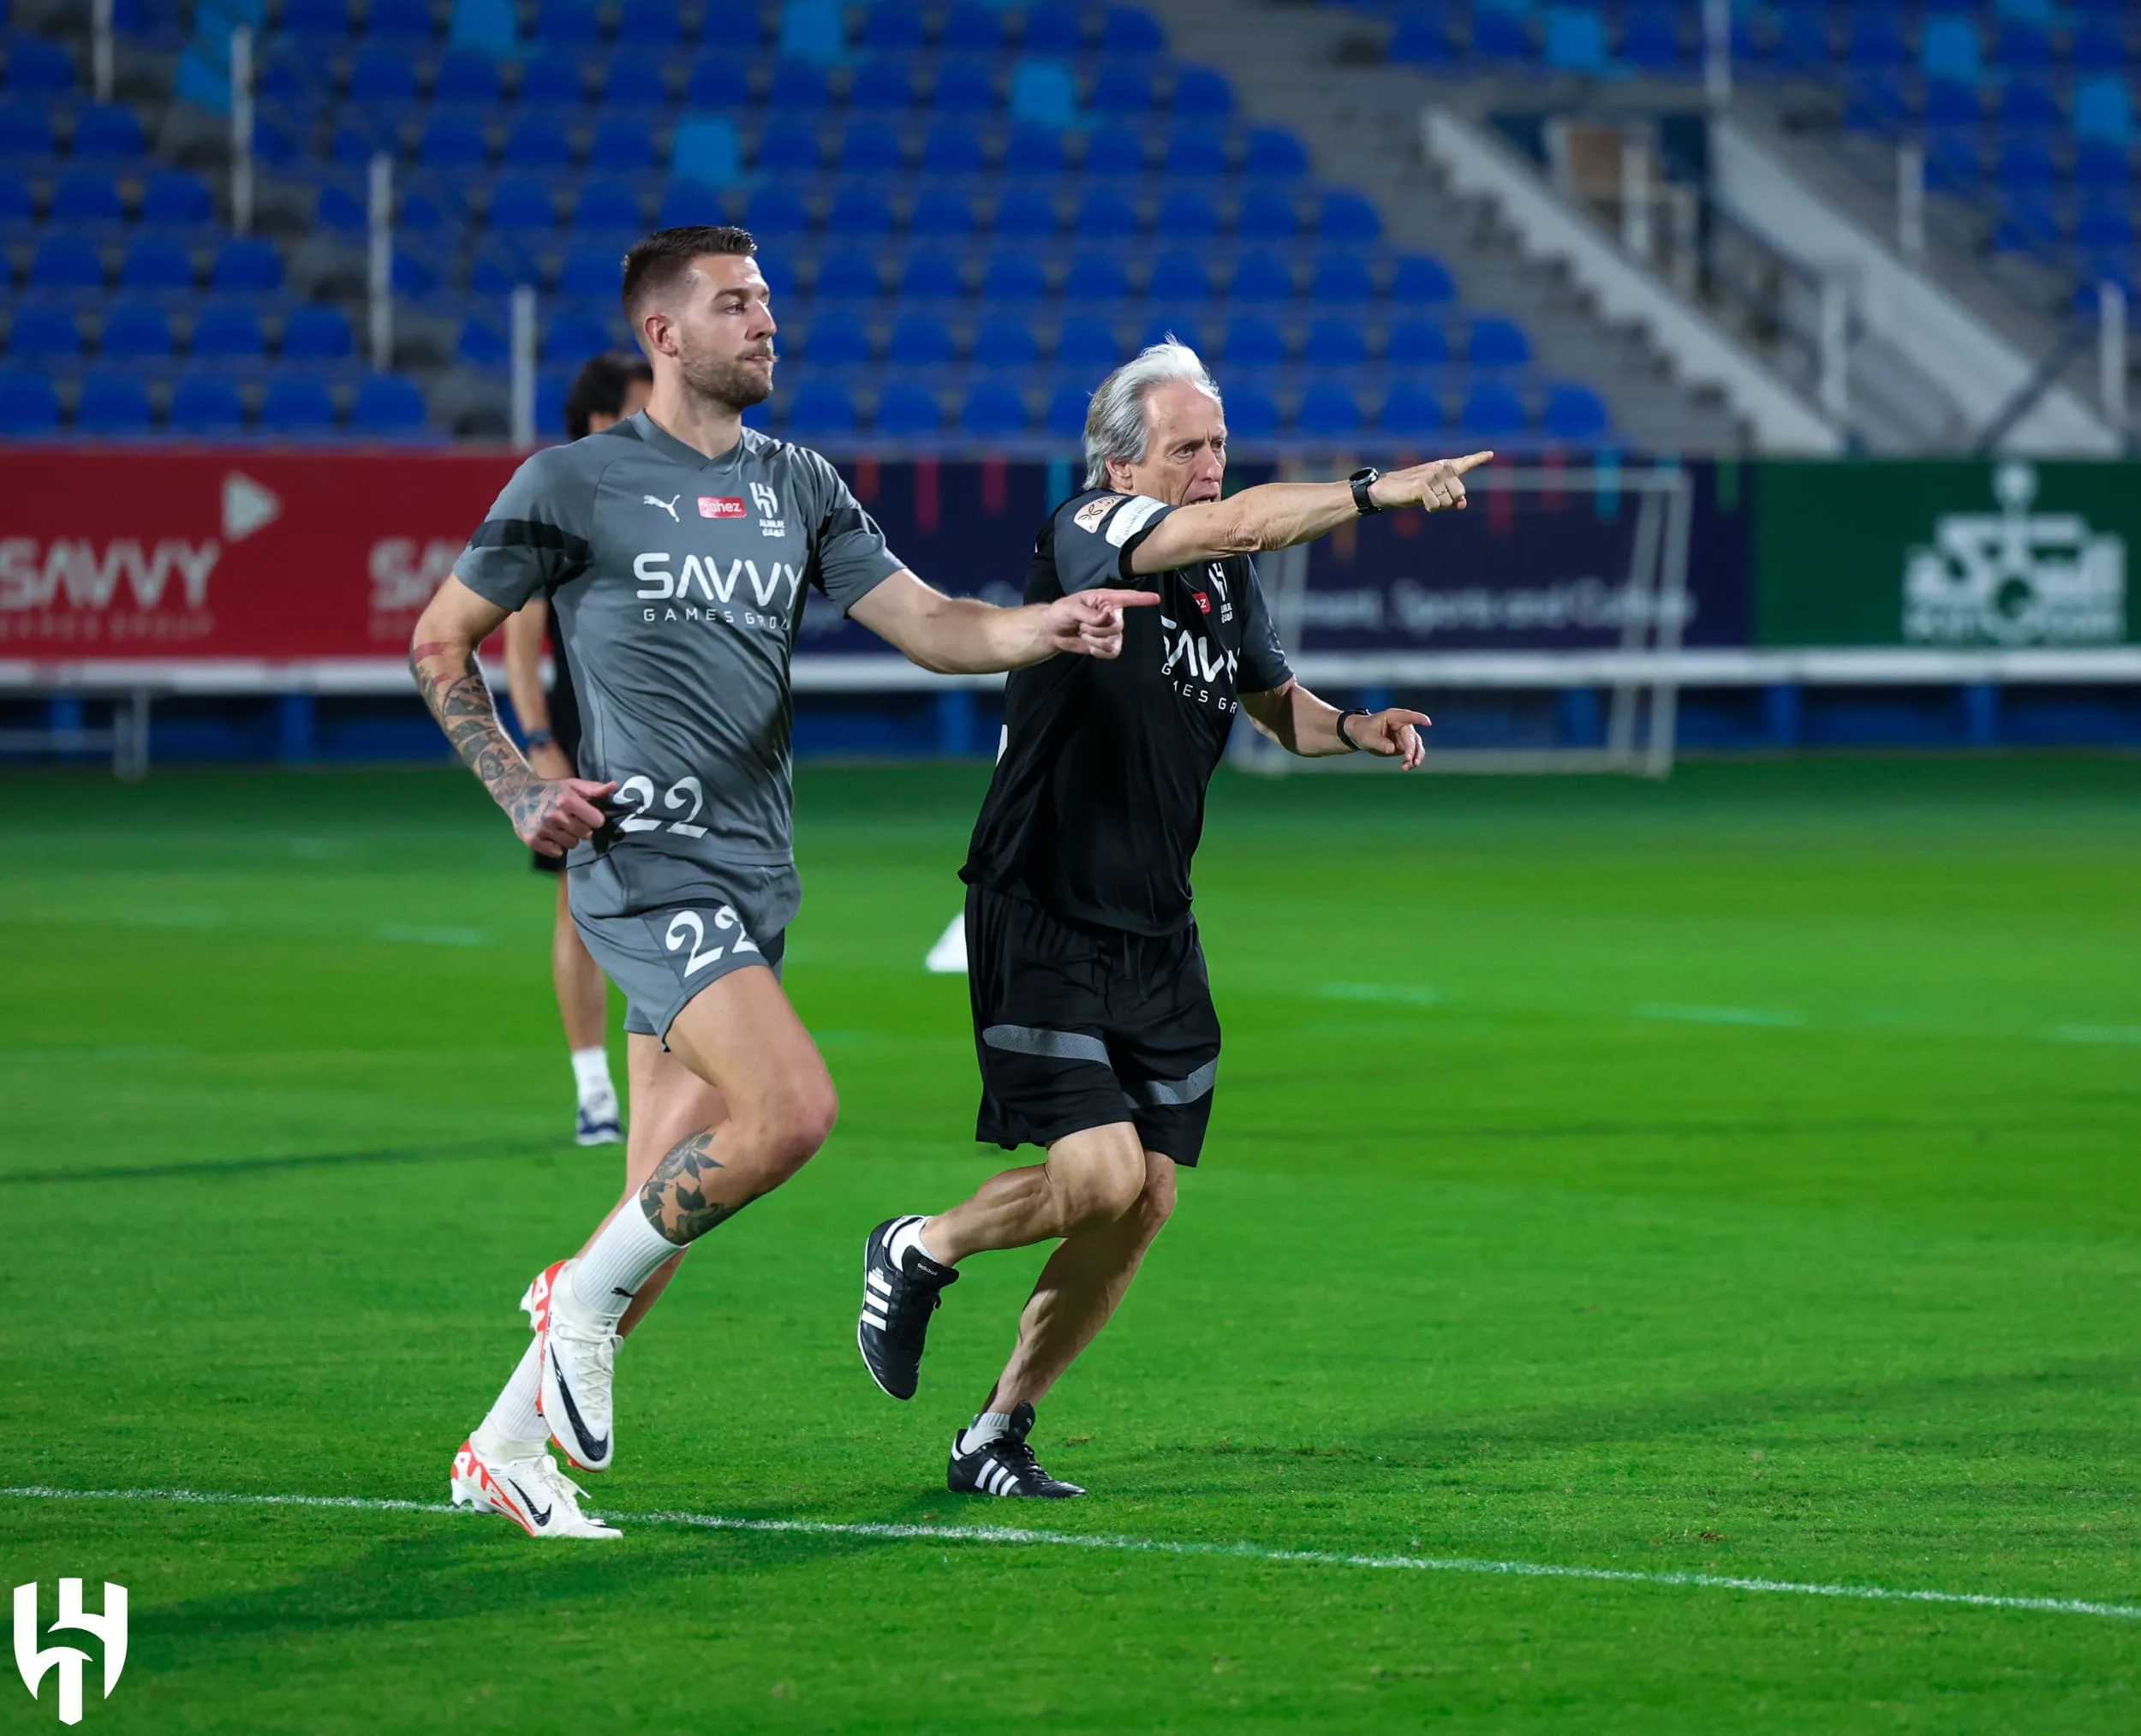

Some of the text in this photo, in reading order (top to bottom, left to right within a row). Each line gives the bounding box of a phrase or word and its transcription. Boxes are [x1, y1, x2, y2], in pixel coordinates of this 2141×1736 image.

[0, 537, 219, 610] SAVVY
[633, 552, 803, 611] SAVVY
[643, 607, 790, 631] GAMES GROU
[612, 775, 709, 839] 22
[665, 904, 760, 978] 22
